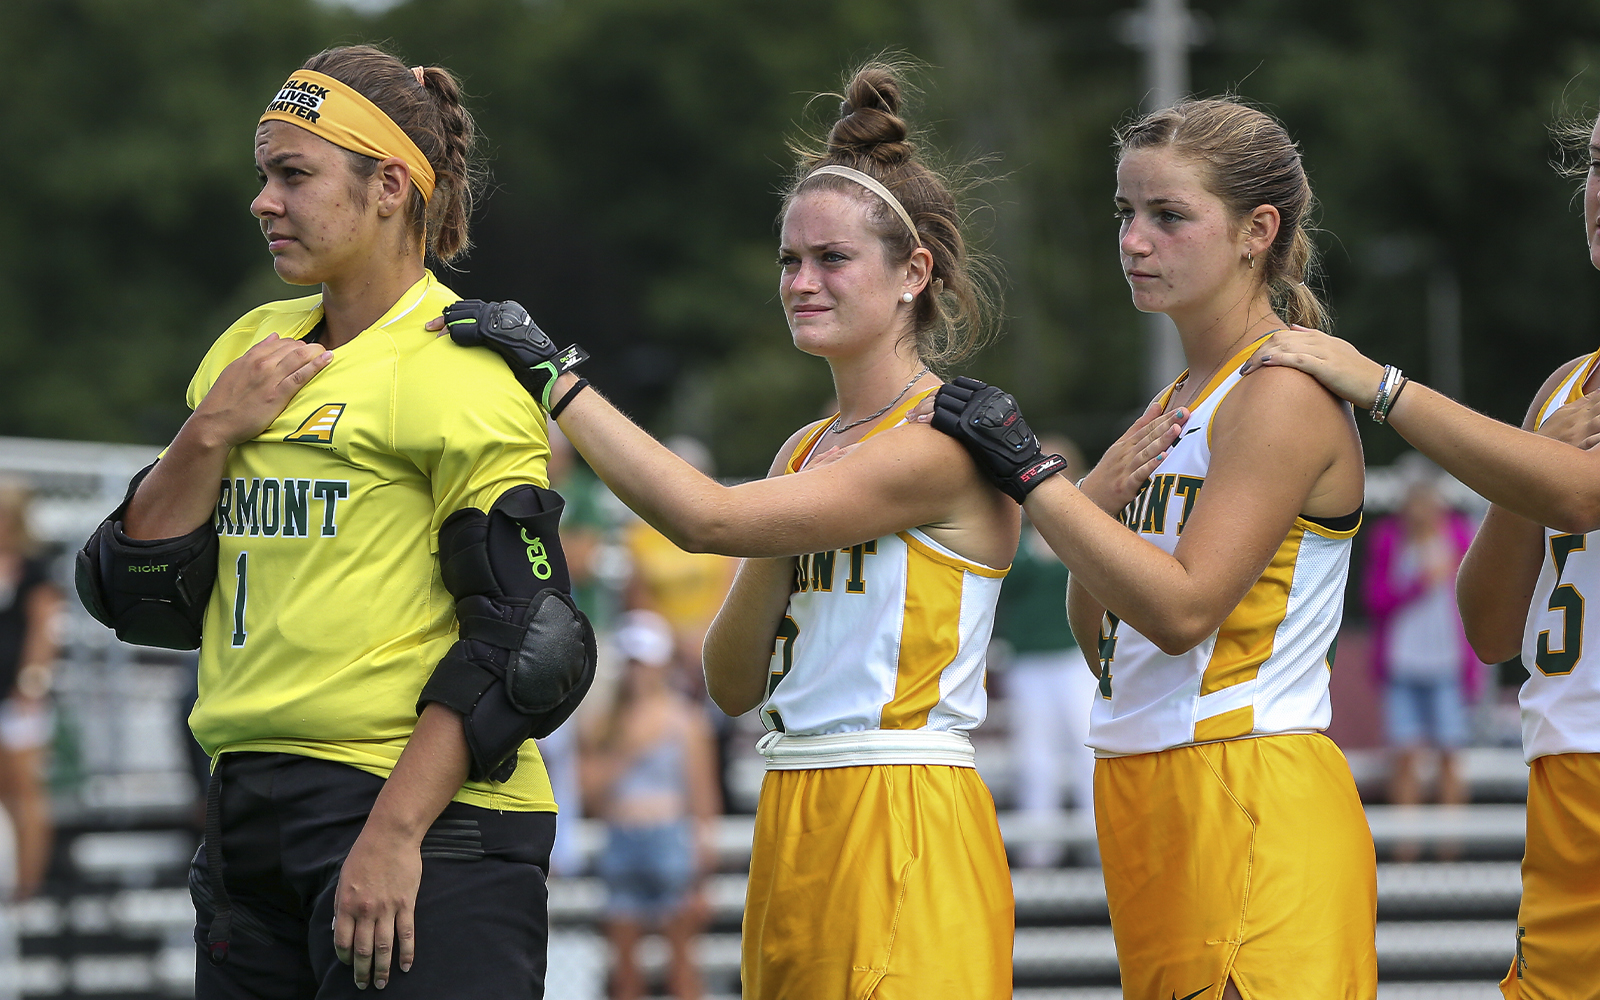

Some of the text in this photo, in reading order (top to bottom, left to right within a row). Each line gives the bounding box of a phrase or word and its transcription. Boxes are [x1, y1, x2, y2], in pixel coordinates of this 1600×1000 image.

[278, 90, 320, 108] LIVES
[284, 80, 330, 100] BLACK
[267, 101, 320, 124] MATTER
[1118, 473, 1206, 536] ONT
[128, 564, 169, 573] RIGHT
[231, 551, 248, 648] 1
[1535, 533, 1587, 677] 5
